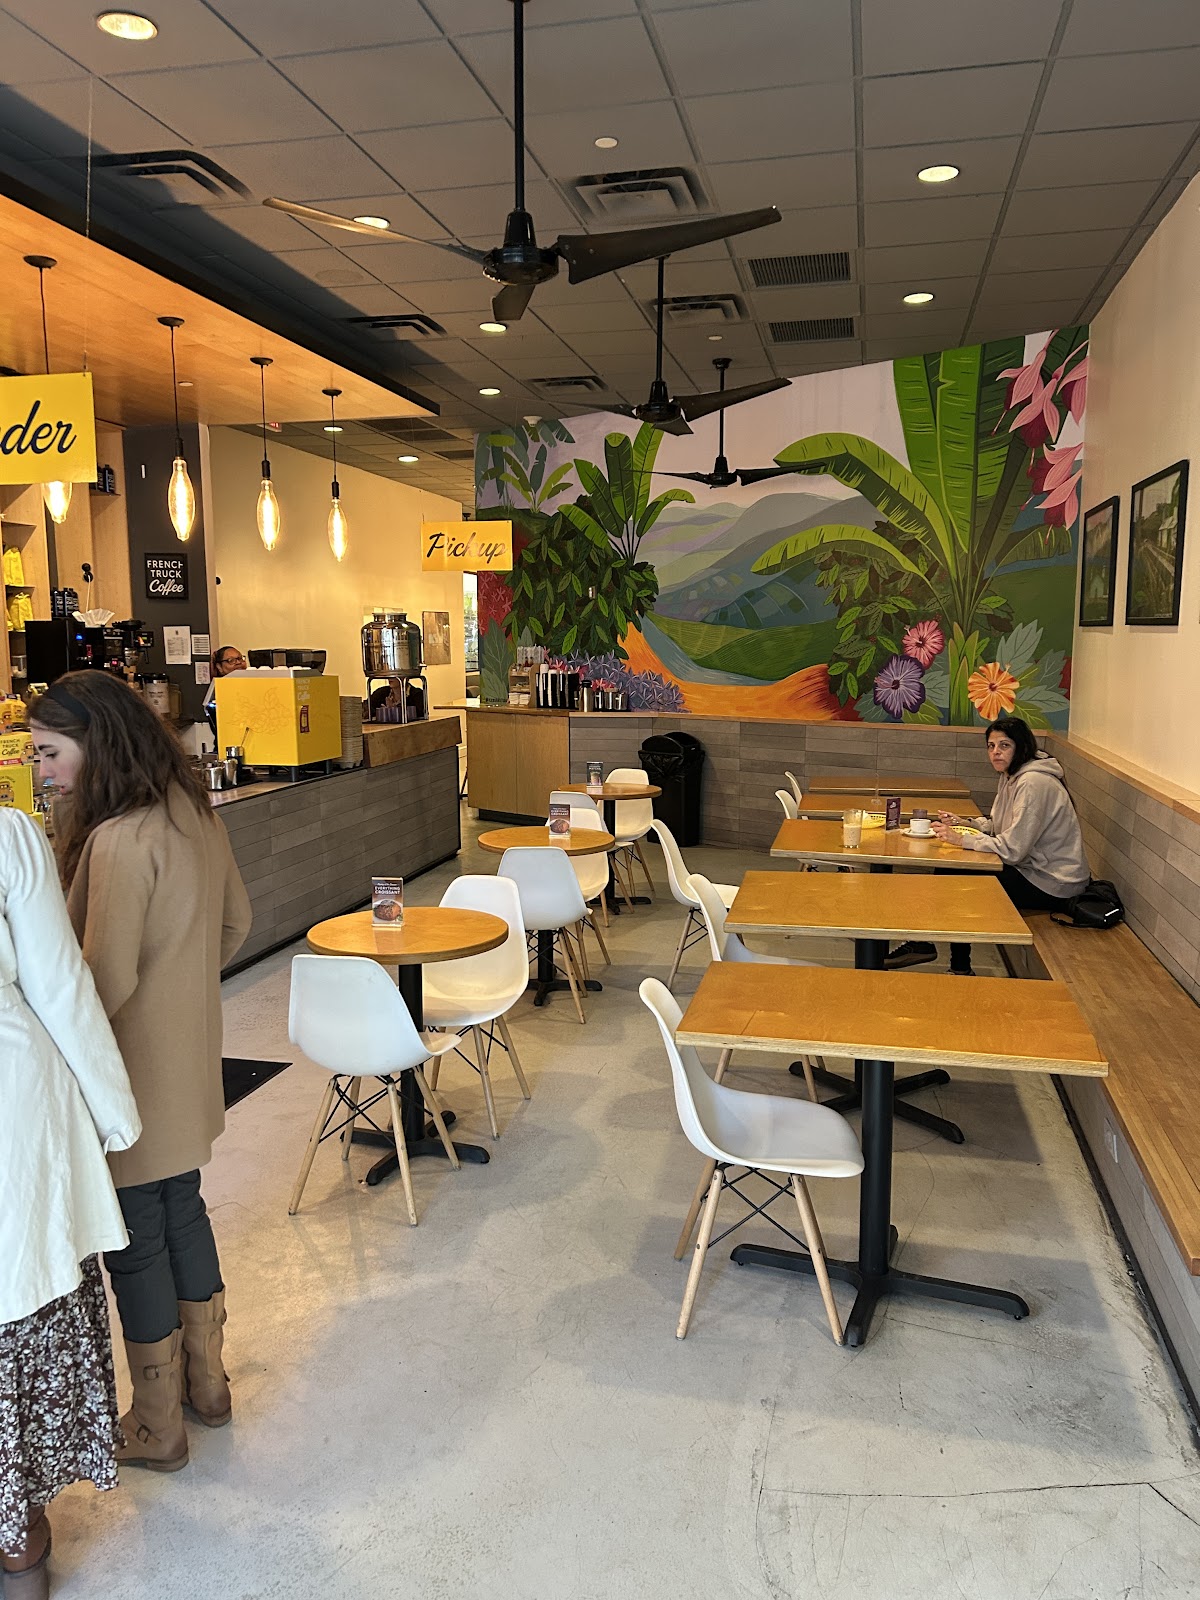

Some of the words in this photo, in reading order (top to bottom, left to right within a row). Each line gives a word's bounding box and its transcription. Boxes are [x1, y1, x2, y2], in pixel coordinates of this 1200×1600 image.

[0, 399, 77, 455] der
[426, 531, 508, 565] Pickup
[146, 559, 184, 569] FRENCH
[150, 569, 182, 579] TRUCK
[149, 578, 185, 596] Coffee
[1, 748, 20, 757] Coffee
